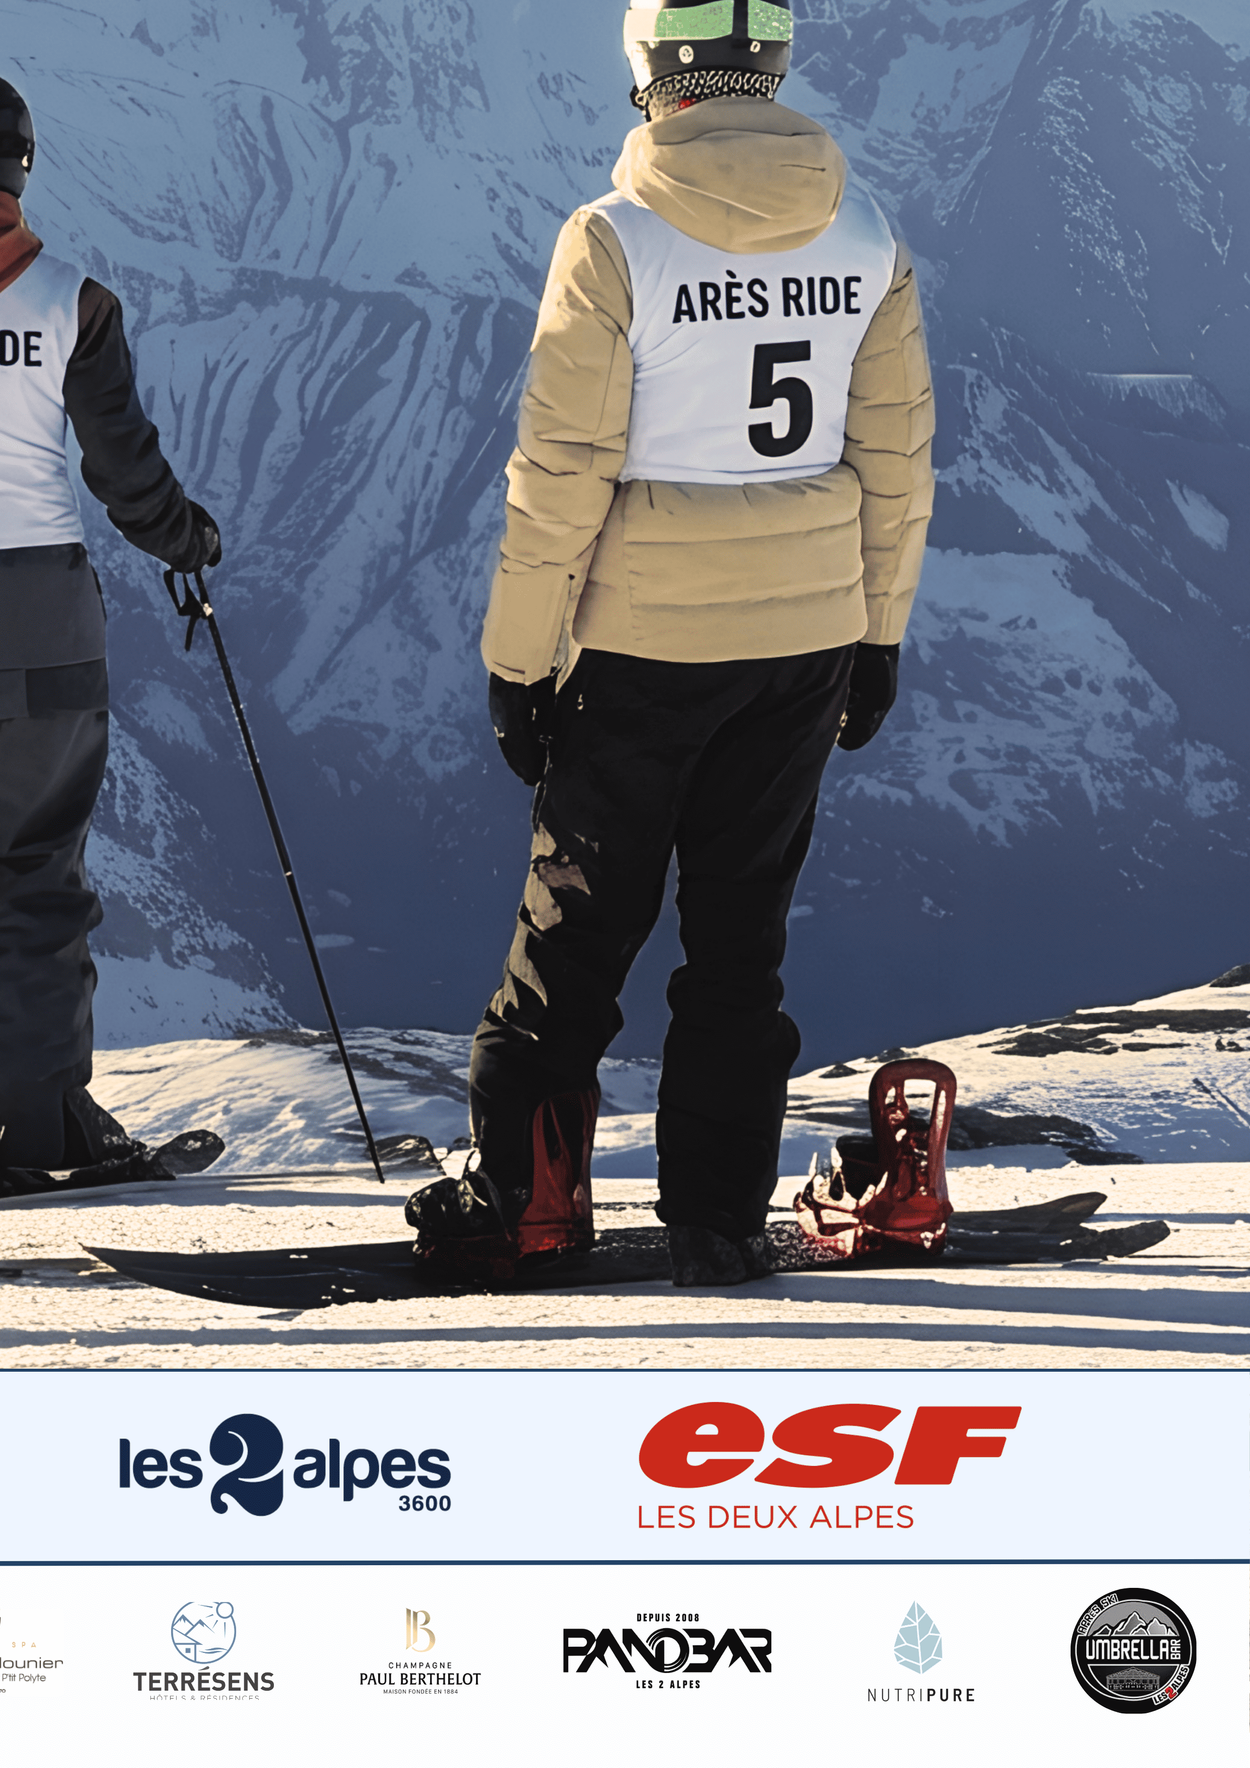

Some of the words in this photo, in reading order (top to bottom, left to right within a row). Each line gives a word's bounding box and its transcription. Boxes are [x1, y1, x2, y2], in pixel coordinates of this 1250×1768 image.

[672, 270, 769, 324] ARÈS
[783, 275, 862, 318] RIDE
[747, 339, 814, 459] 5
[399, 1495, 451, 1511] 3600
[639, 1505, 695, 1528] LES
[709, 1506, 797, 1528] DEUX
[810, 1505, 914, 1528] ALPES
[1100, 1593, 1118, 1608] SKI
[637, 1613, 670, 1622] DEPUIS
[676, 1613, 699, 1622] 2008
[11, 1641, 37, 1649] SPA
[563, 1628, 772, 1673] PANOBAR
[1086, 1640, 1168, 1659] UMBRELLA
[1170, 1639, 1181, 1660] BAR
[388, 1661, 452, 1669] CHAMPAGNE
[19, 1673, 47, 1684] Polyte
[133, 1662, 274, 1691] TERRÉSENS
[360, 1673, 395, 1685] PAUL
[401, 1673, 481, 1685] BERTHELOT
[1170, 1666, 1189, 1690] ALPES
[636, 1680, 653, 1689] LES
[659, 1680, 663, 1688] 2
[670, 1680, 700, 1689] ALPES
[867, 1688, 975, 1702] NUTRIPURE
[1152, 1692, 1168, 1703] LES
[1165, 1686, 1178, 1699] 2
